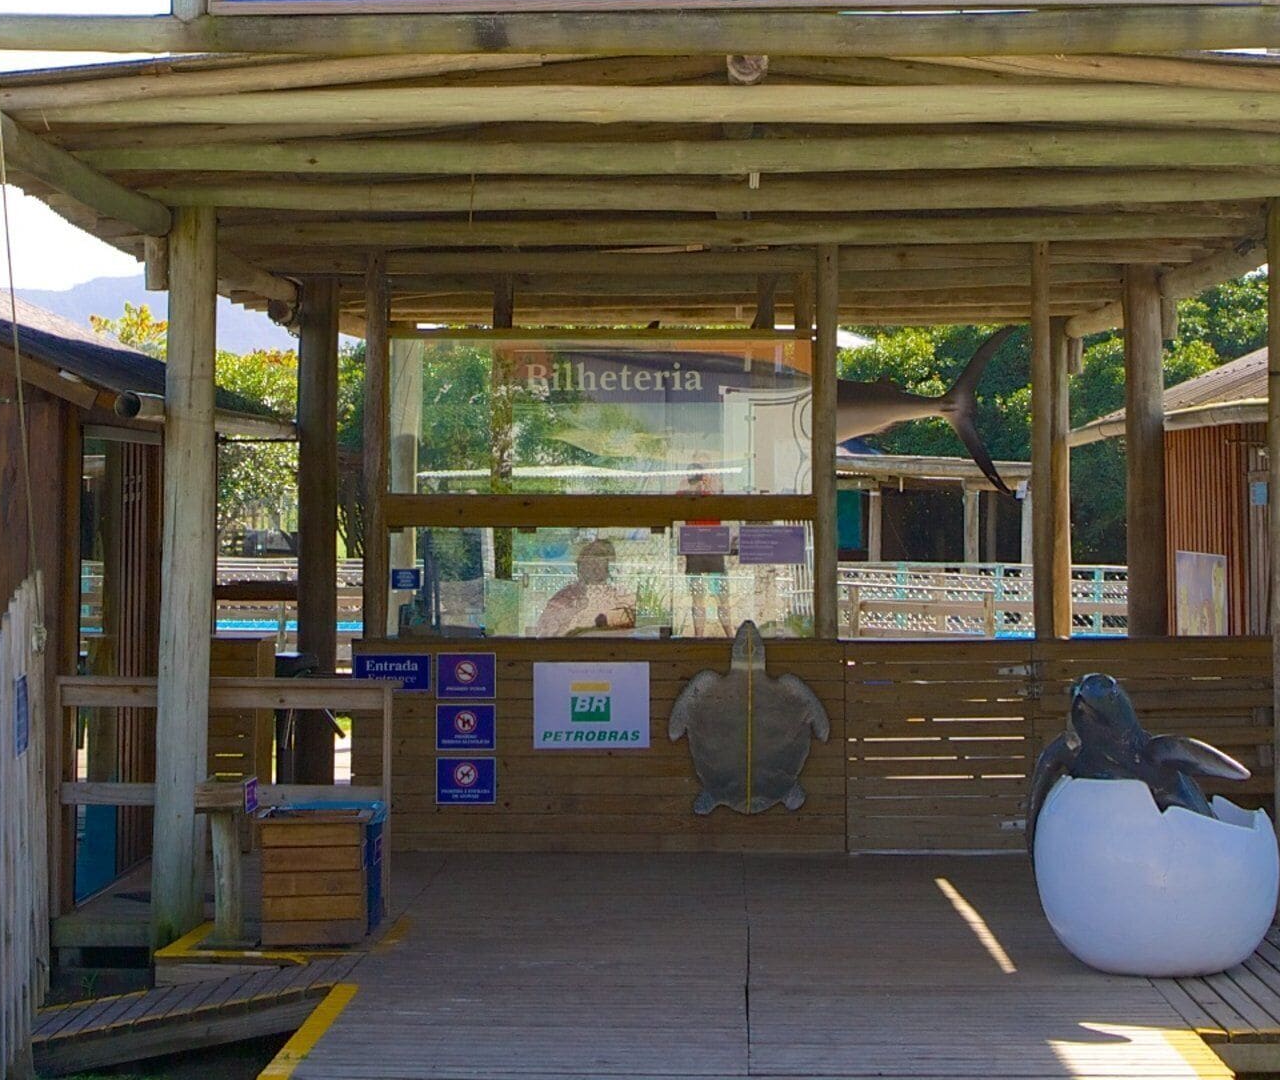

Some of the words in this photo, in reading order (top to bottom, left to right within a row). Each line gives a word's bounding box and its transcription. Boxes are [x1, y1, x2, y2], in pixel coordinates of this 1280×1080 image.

[525, 362, 703, 391] Bilheteria
[366, 660, 419, 671] Entrada
[574, 696, 608, 712] BR
[542, 731, 640, 742] PETROBRAS
